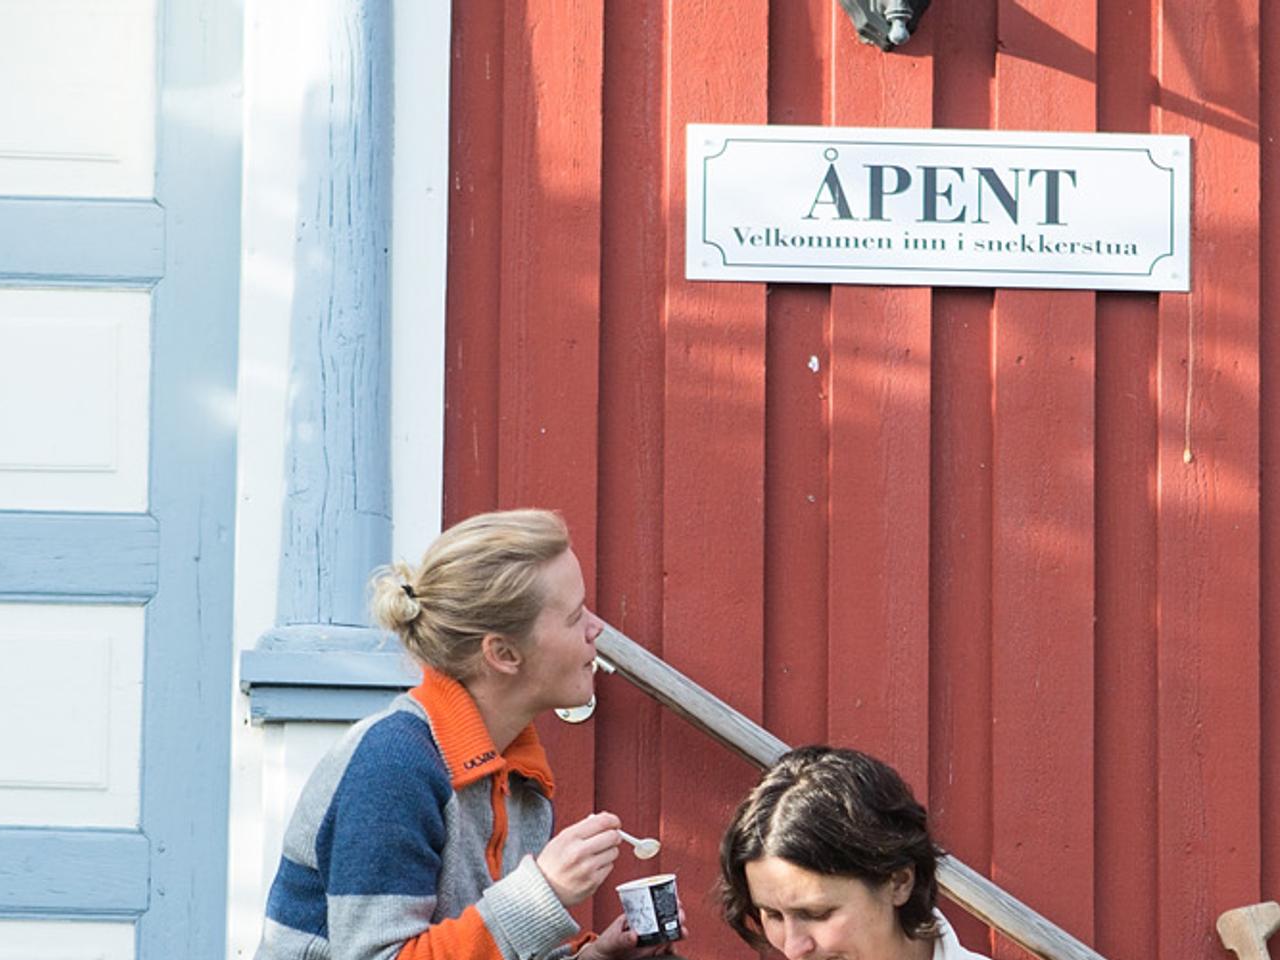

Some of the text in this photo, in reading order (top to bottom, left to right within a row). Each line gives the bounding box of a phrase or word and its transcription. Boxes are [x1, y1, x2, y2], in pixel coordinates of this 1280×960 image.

[801, 147, 1077, 226] ÅPENT
[732, 227, 1139, 256] Velkommen inn i snekkerstua
